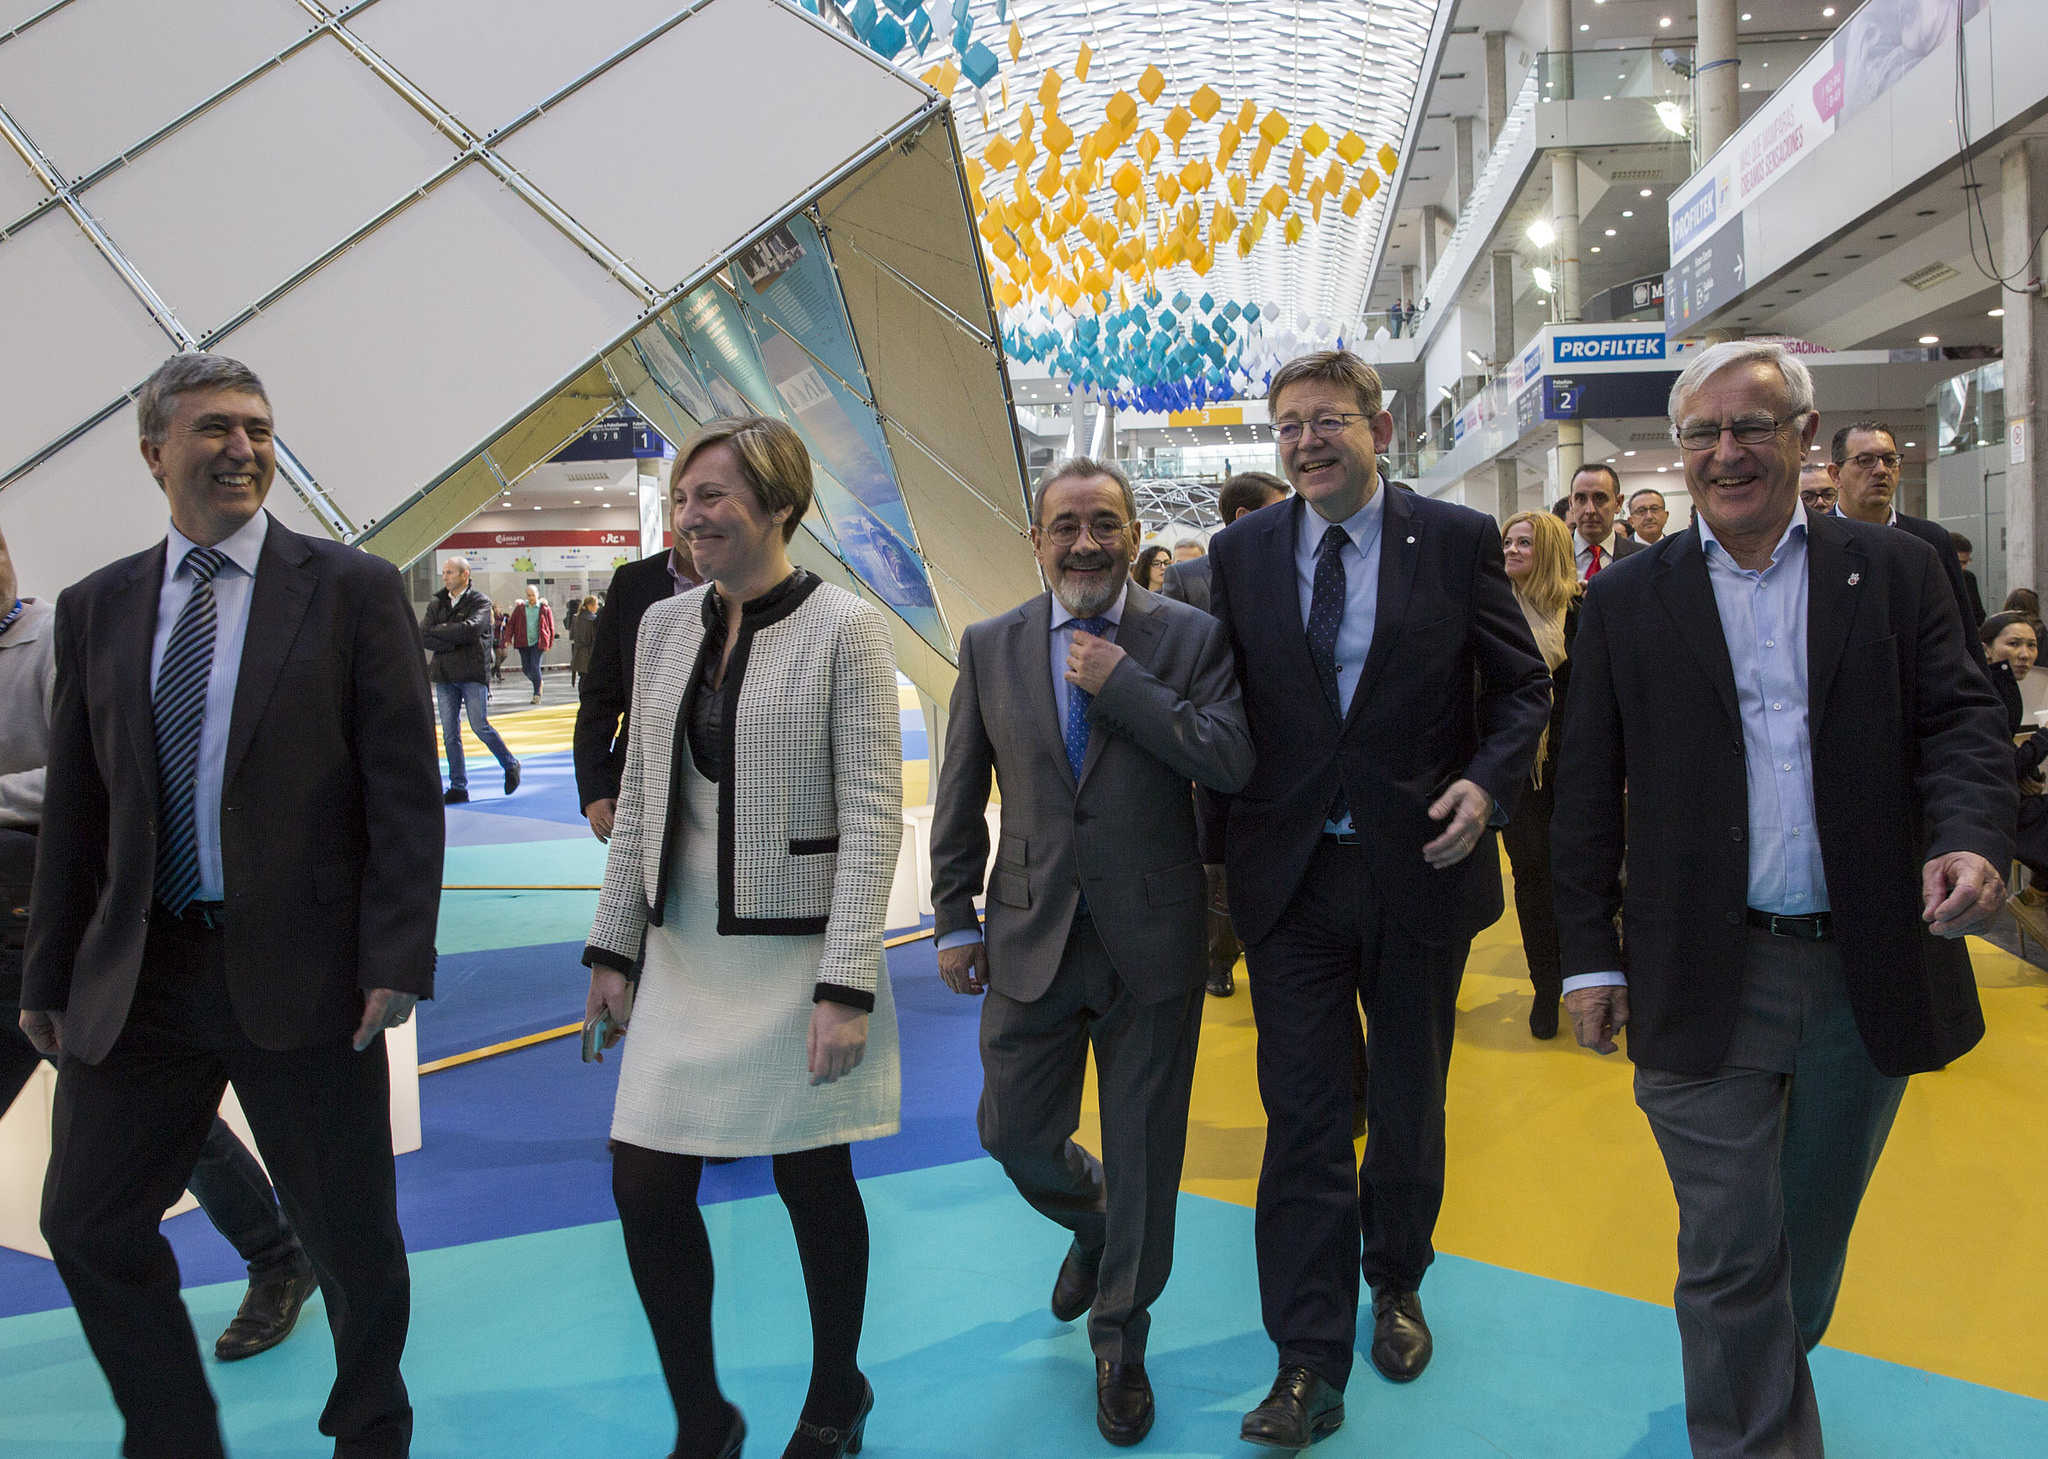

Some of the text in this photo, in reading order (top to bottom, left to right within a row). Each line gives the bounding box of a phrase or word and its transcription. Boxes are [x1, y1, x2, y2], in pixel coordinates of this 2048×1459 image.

[1765, 122, 1803, 178] SENSACIONES
[1674, 187, 1715, 244] PROFILTEK
[1559, 338, 1660, 358] PROFILTEK
[1560, 392, 1571, 409] 2
[1201, 411, 1210, 424] 3
[641, 432, 648, 449] 1
